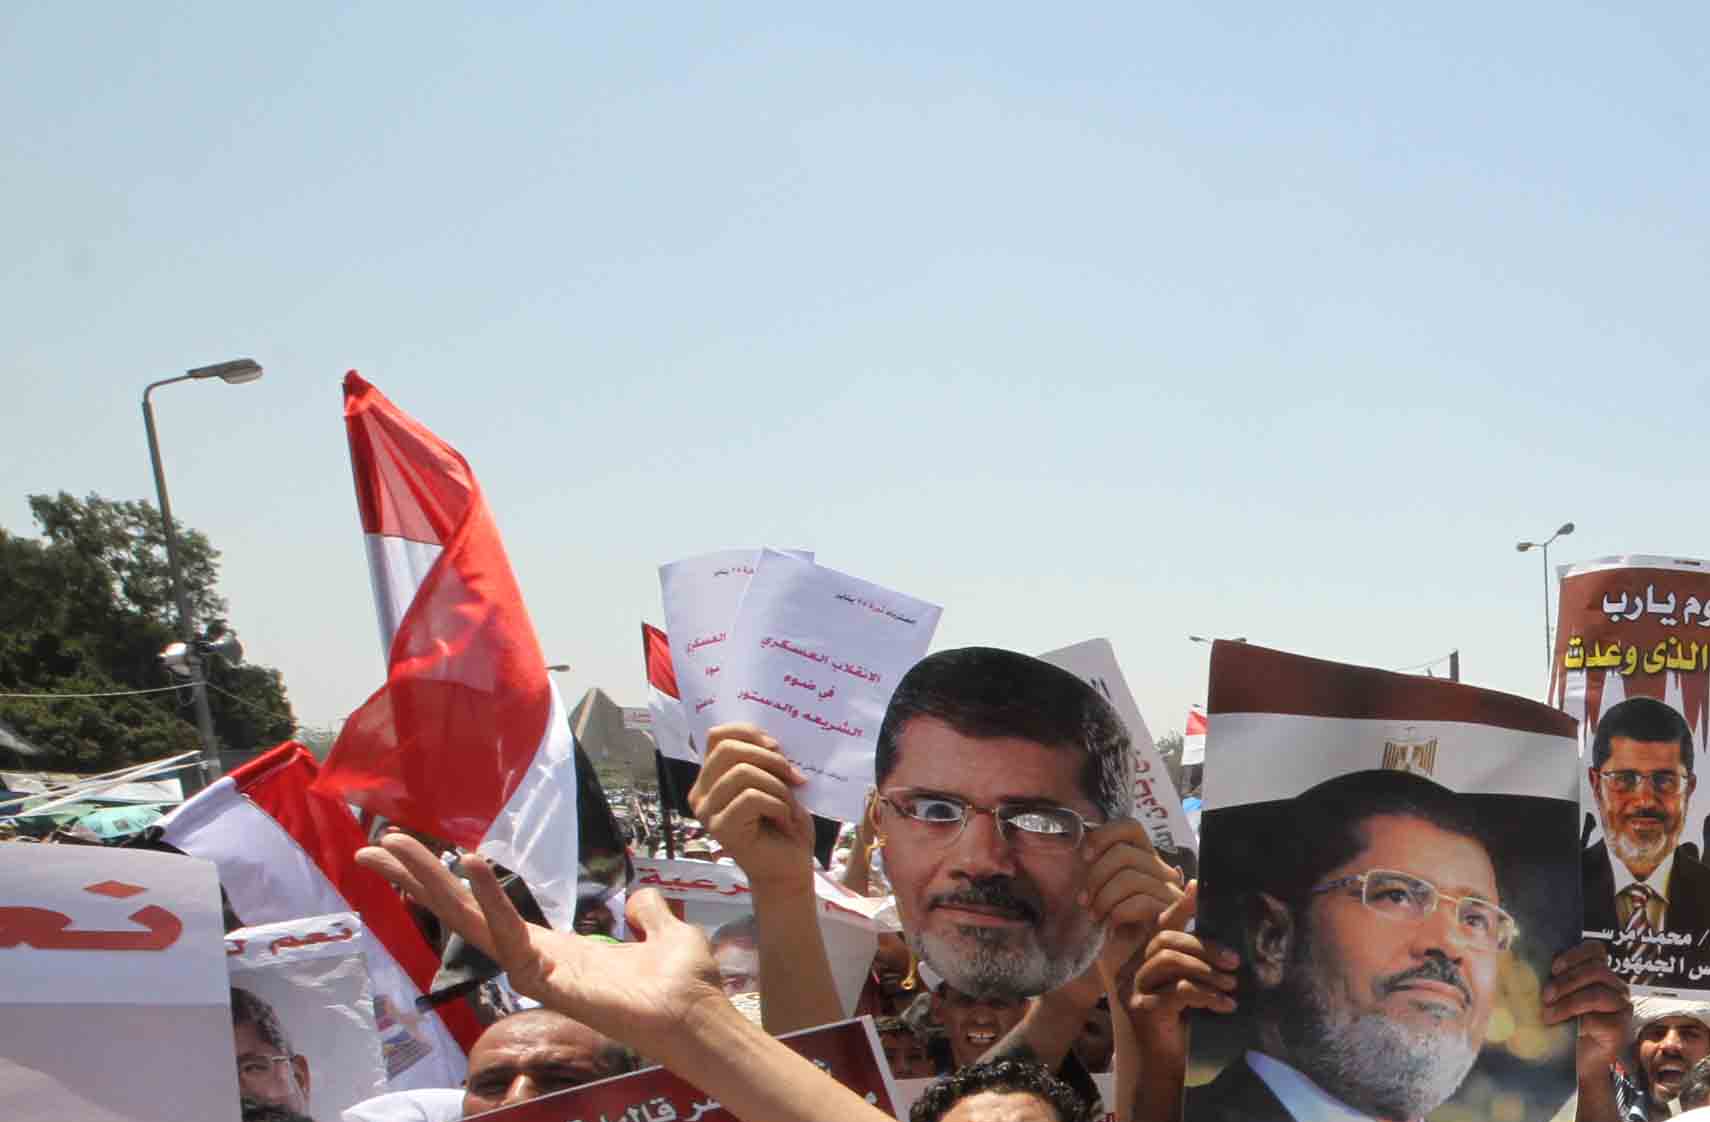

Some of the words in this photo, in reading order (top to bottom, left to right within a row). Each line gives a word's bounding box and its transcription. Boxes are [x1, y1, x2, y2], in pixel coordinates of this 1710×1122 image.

[1602, 583, 1677, 626] يارب
[1643, 636, 1709, 674] الذى
[1581, 928, 1638, 947] مرس
[1640, 928, 1693, 947] محمد
